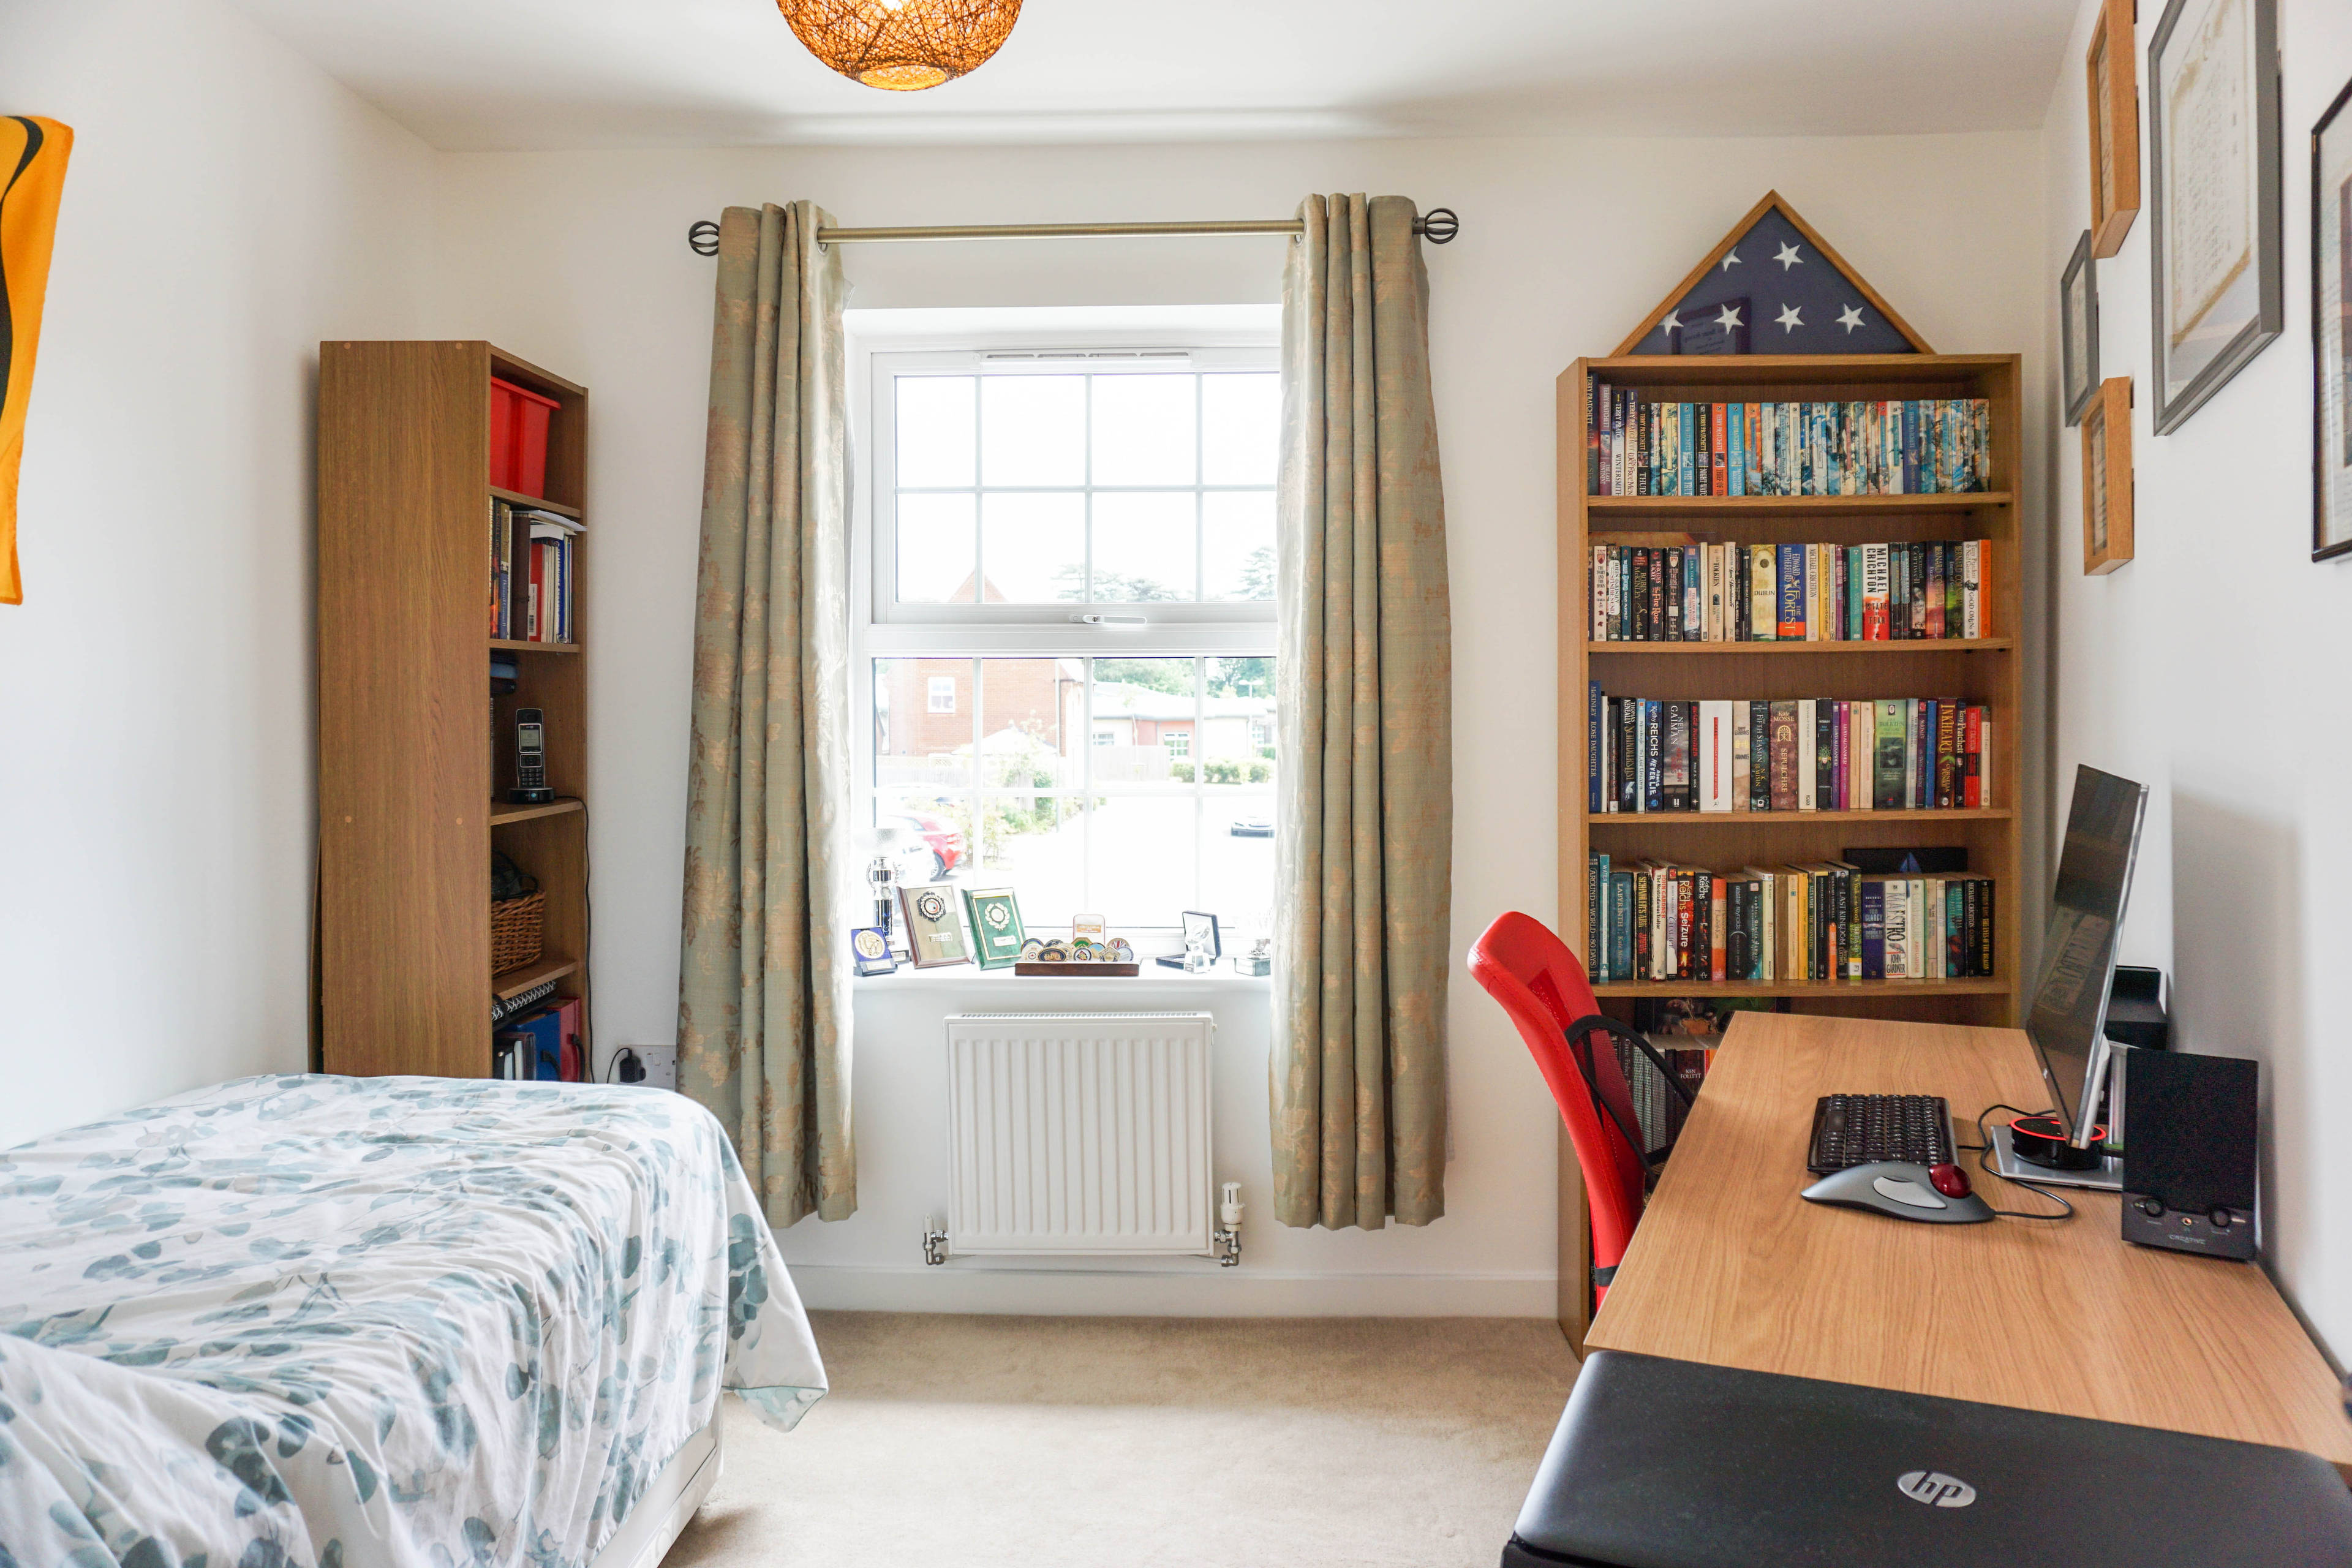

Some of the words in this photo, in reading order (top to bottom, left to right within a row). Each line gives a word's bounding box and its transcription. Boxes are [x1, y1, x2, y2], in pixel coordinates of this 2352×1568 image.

[1867, 548, 1877, 593] CRICHTON
[1877, 548, 1887, 593] MICHAEL
[1652, 608, 1661, 624] Rose
[1784, 588, 1801, 631] FOREST
[1939, 704, 1955, 753] INKHEART
[1957, 723, 1966, 753] Pratchett
[1679, 881, 1691, 909] Reichs
[1699, 876, 1709, 899] Reichs
[1638, 915, 1647, 927] ARK
[1887, 893, 1905, 941] MAESTRO
[1887, 964, 1905, 973] GARDNER
[1891, 954, 1901, 963] JOHN
[2168, 1234, 2205, 1245] CREATIVE
[1912, 1470, 1964, 1506] hp
